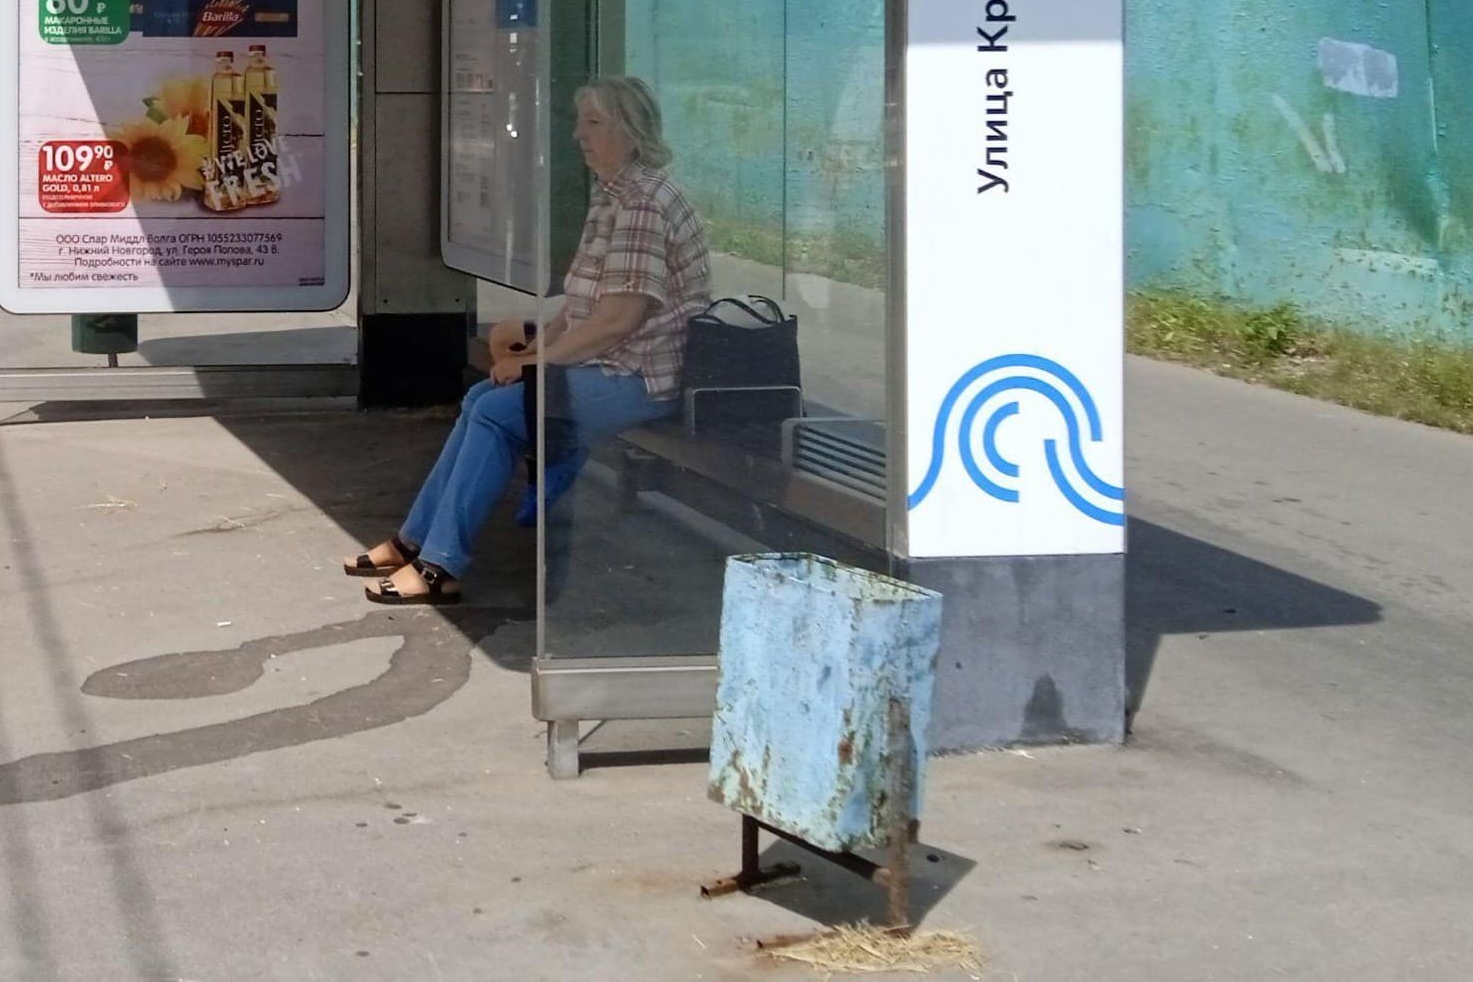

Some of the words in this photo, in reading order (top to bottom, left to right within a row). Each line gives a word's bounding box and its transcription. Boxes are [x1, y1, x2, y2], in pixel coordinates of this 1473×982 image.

[202, 11, 239, 22] Barilla
[976, 68, 1013, 195] Улица
[42, 145, 93, 172] 109
[94, 145, 114, 159] 90
[42, 174, 78, 183] МАСЛО
[79, 174, 113, 183] ALTERO
[203, 154, 303, 212] FRESH
[42, 184, 71, 193] GOLD,
[56, 234, 80, 243] ООО
[82, 234, 108, 245] Спар
[110, 234, 145, 245] Миддл
[146, 234, 177, 243] Волга
[178, 233, 205, 243] ОГРН
[68, 246, 109, 255] Нижний
[112, 246, 163, 257] Новгород,
[183, 245, 212, 256] Героя
[214, 245, 254, 256] Попова,
[256, 245, 269, 254] 43
[74, 257, 142, 268] Подробности
[159, 257, 187, 266] сайте
[189, 257, 265, 267] www.myspar.ru
[53, 271, 89, 282] любим
[91, 272, 139, 281] свежесть
